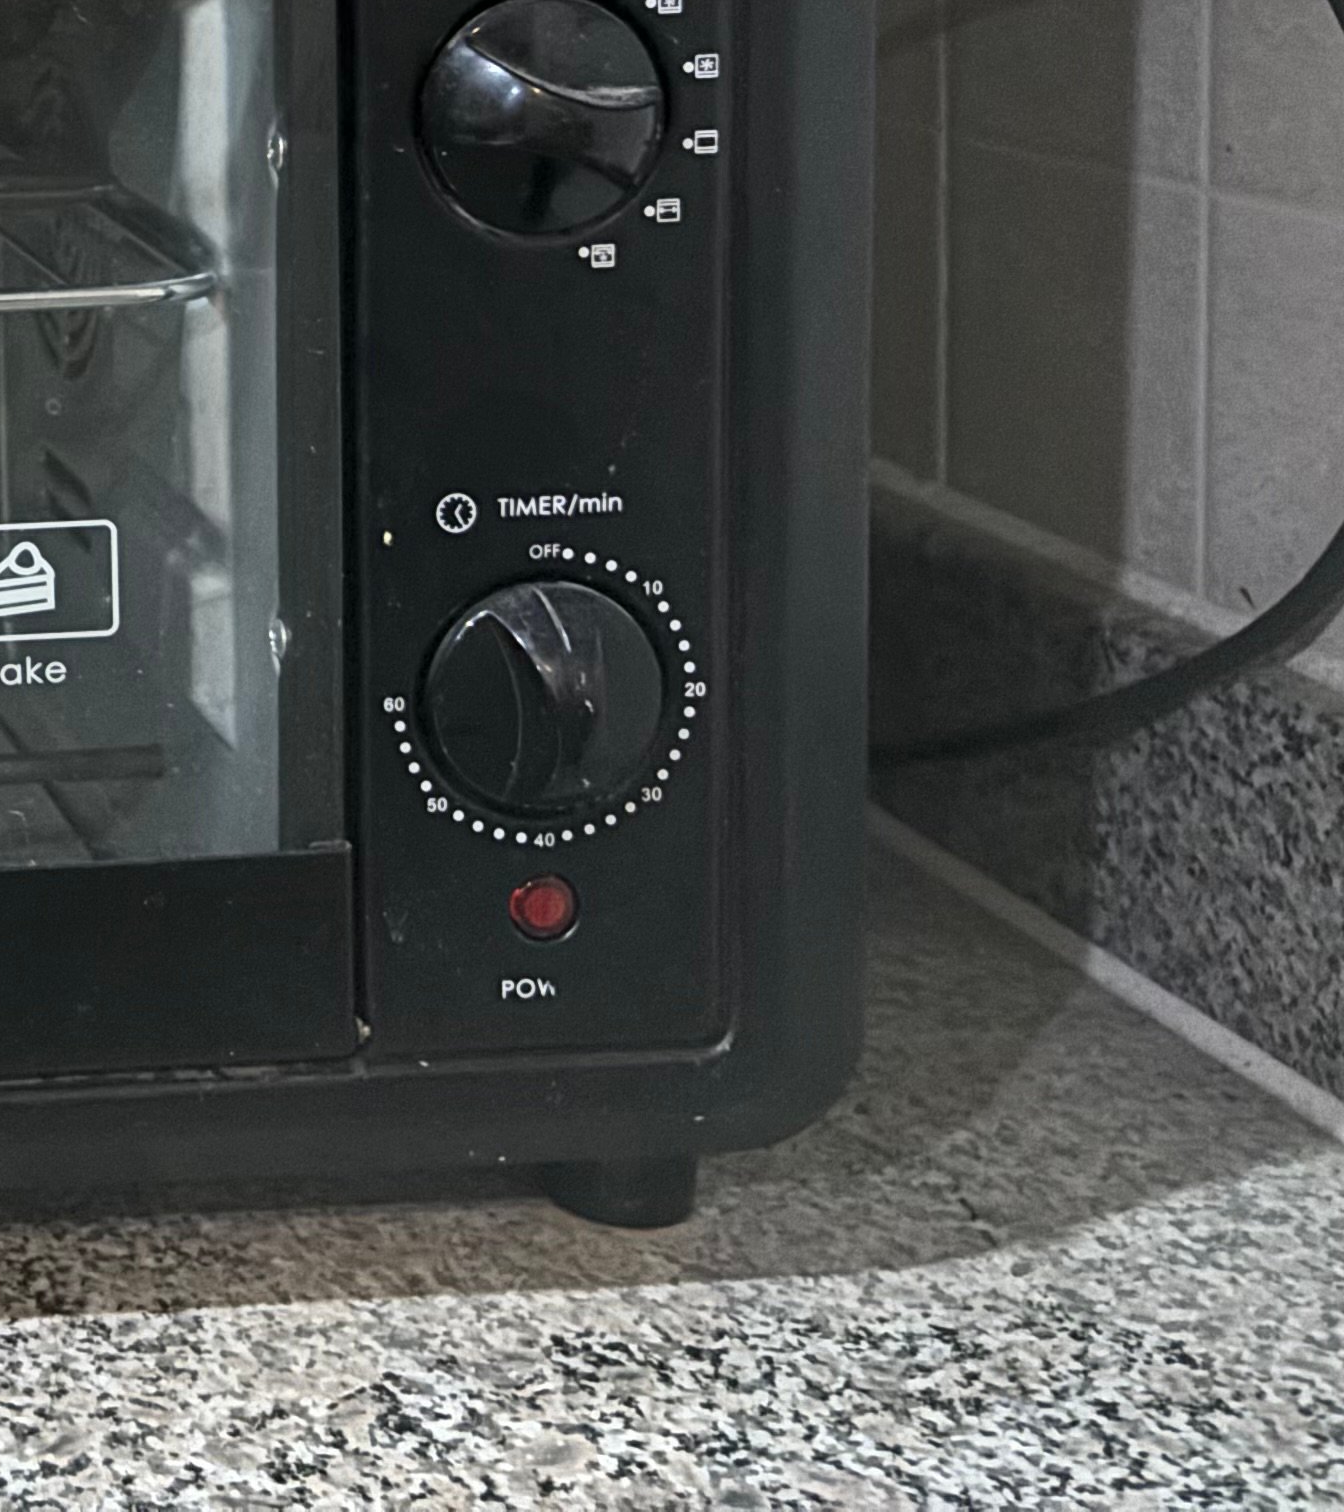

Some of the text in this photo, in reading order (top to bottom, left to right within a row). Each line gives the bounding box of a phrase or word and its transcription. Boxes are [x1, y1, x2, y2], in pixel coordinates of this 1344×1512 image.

[497, 492, 623, 517] TIMER/min
[529, 543, 561, 560] OFF
[643, 580, 663, 595] 10
[684, 681, 707, 698] 20
[383, 696, 405, 713] 60
[642, 786, 663, 802] 30
[427, 797, 448, 813] 50
[533, 832, 555, 847] 40
